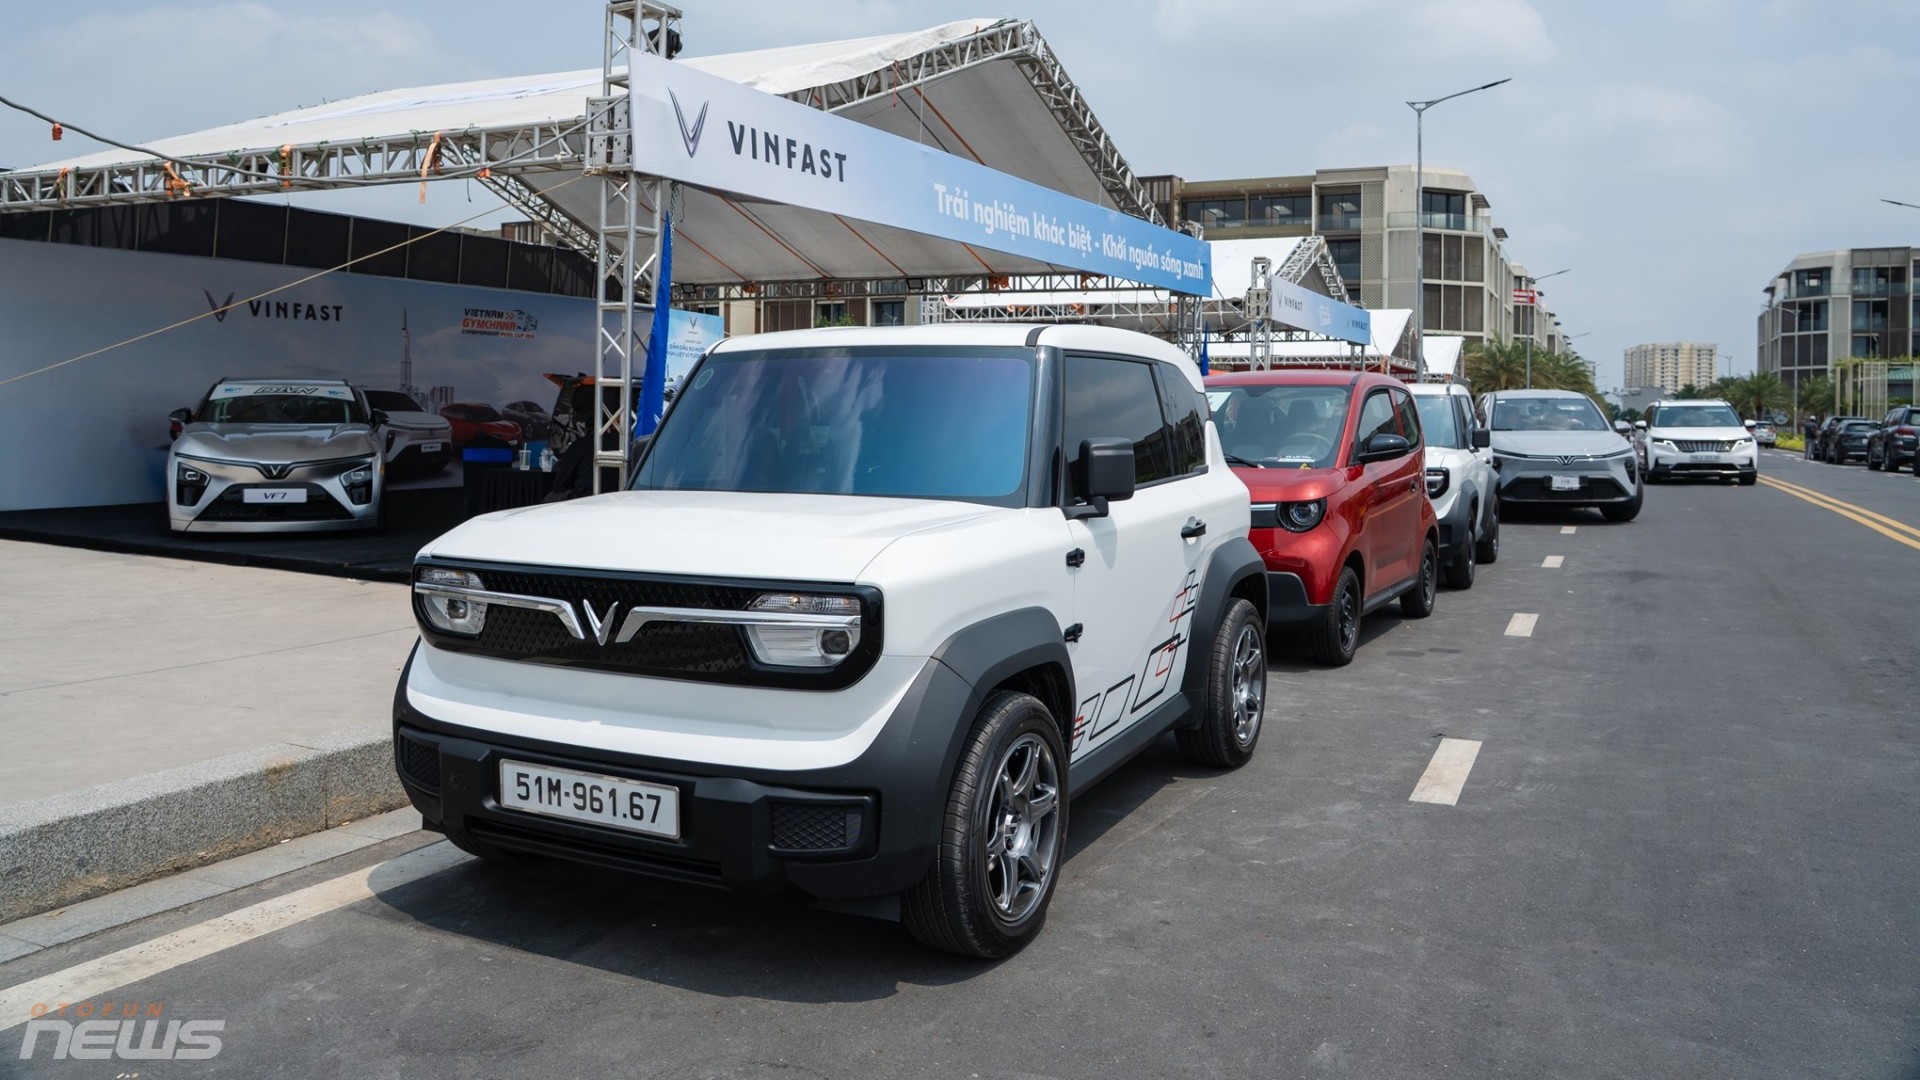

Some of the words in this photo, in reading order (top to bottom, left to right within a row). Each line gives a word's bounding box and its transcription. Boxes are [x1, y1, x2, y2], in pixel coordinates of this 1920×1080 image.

[727, 121, 847, 182] VINFAST
[934, 183, 969, 221] Trải
[974, 200, 1030, 241] nghiệm
[1033, 212, 1065, 246] khác
[1068, 222, 1092, 258] biệt
[1102, 233, 1126, 260] Khởi
[1161, 249, 1181, 280] sống
[1183, 259, 1204, 280] xanh
[248, 300, 343, 321] VINFAST
[463, 318, 516, 331] GYMKHANA
[464, 308, 504, 319] VIETNAM
[516, 772, 662, 824] 51M-961.67
